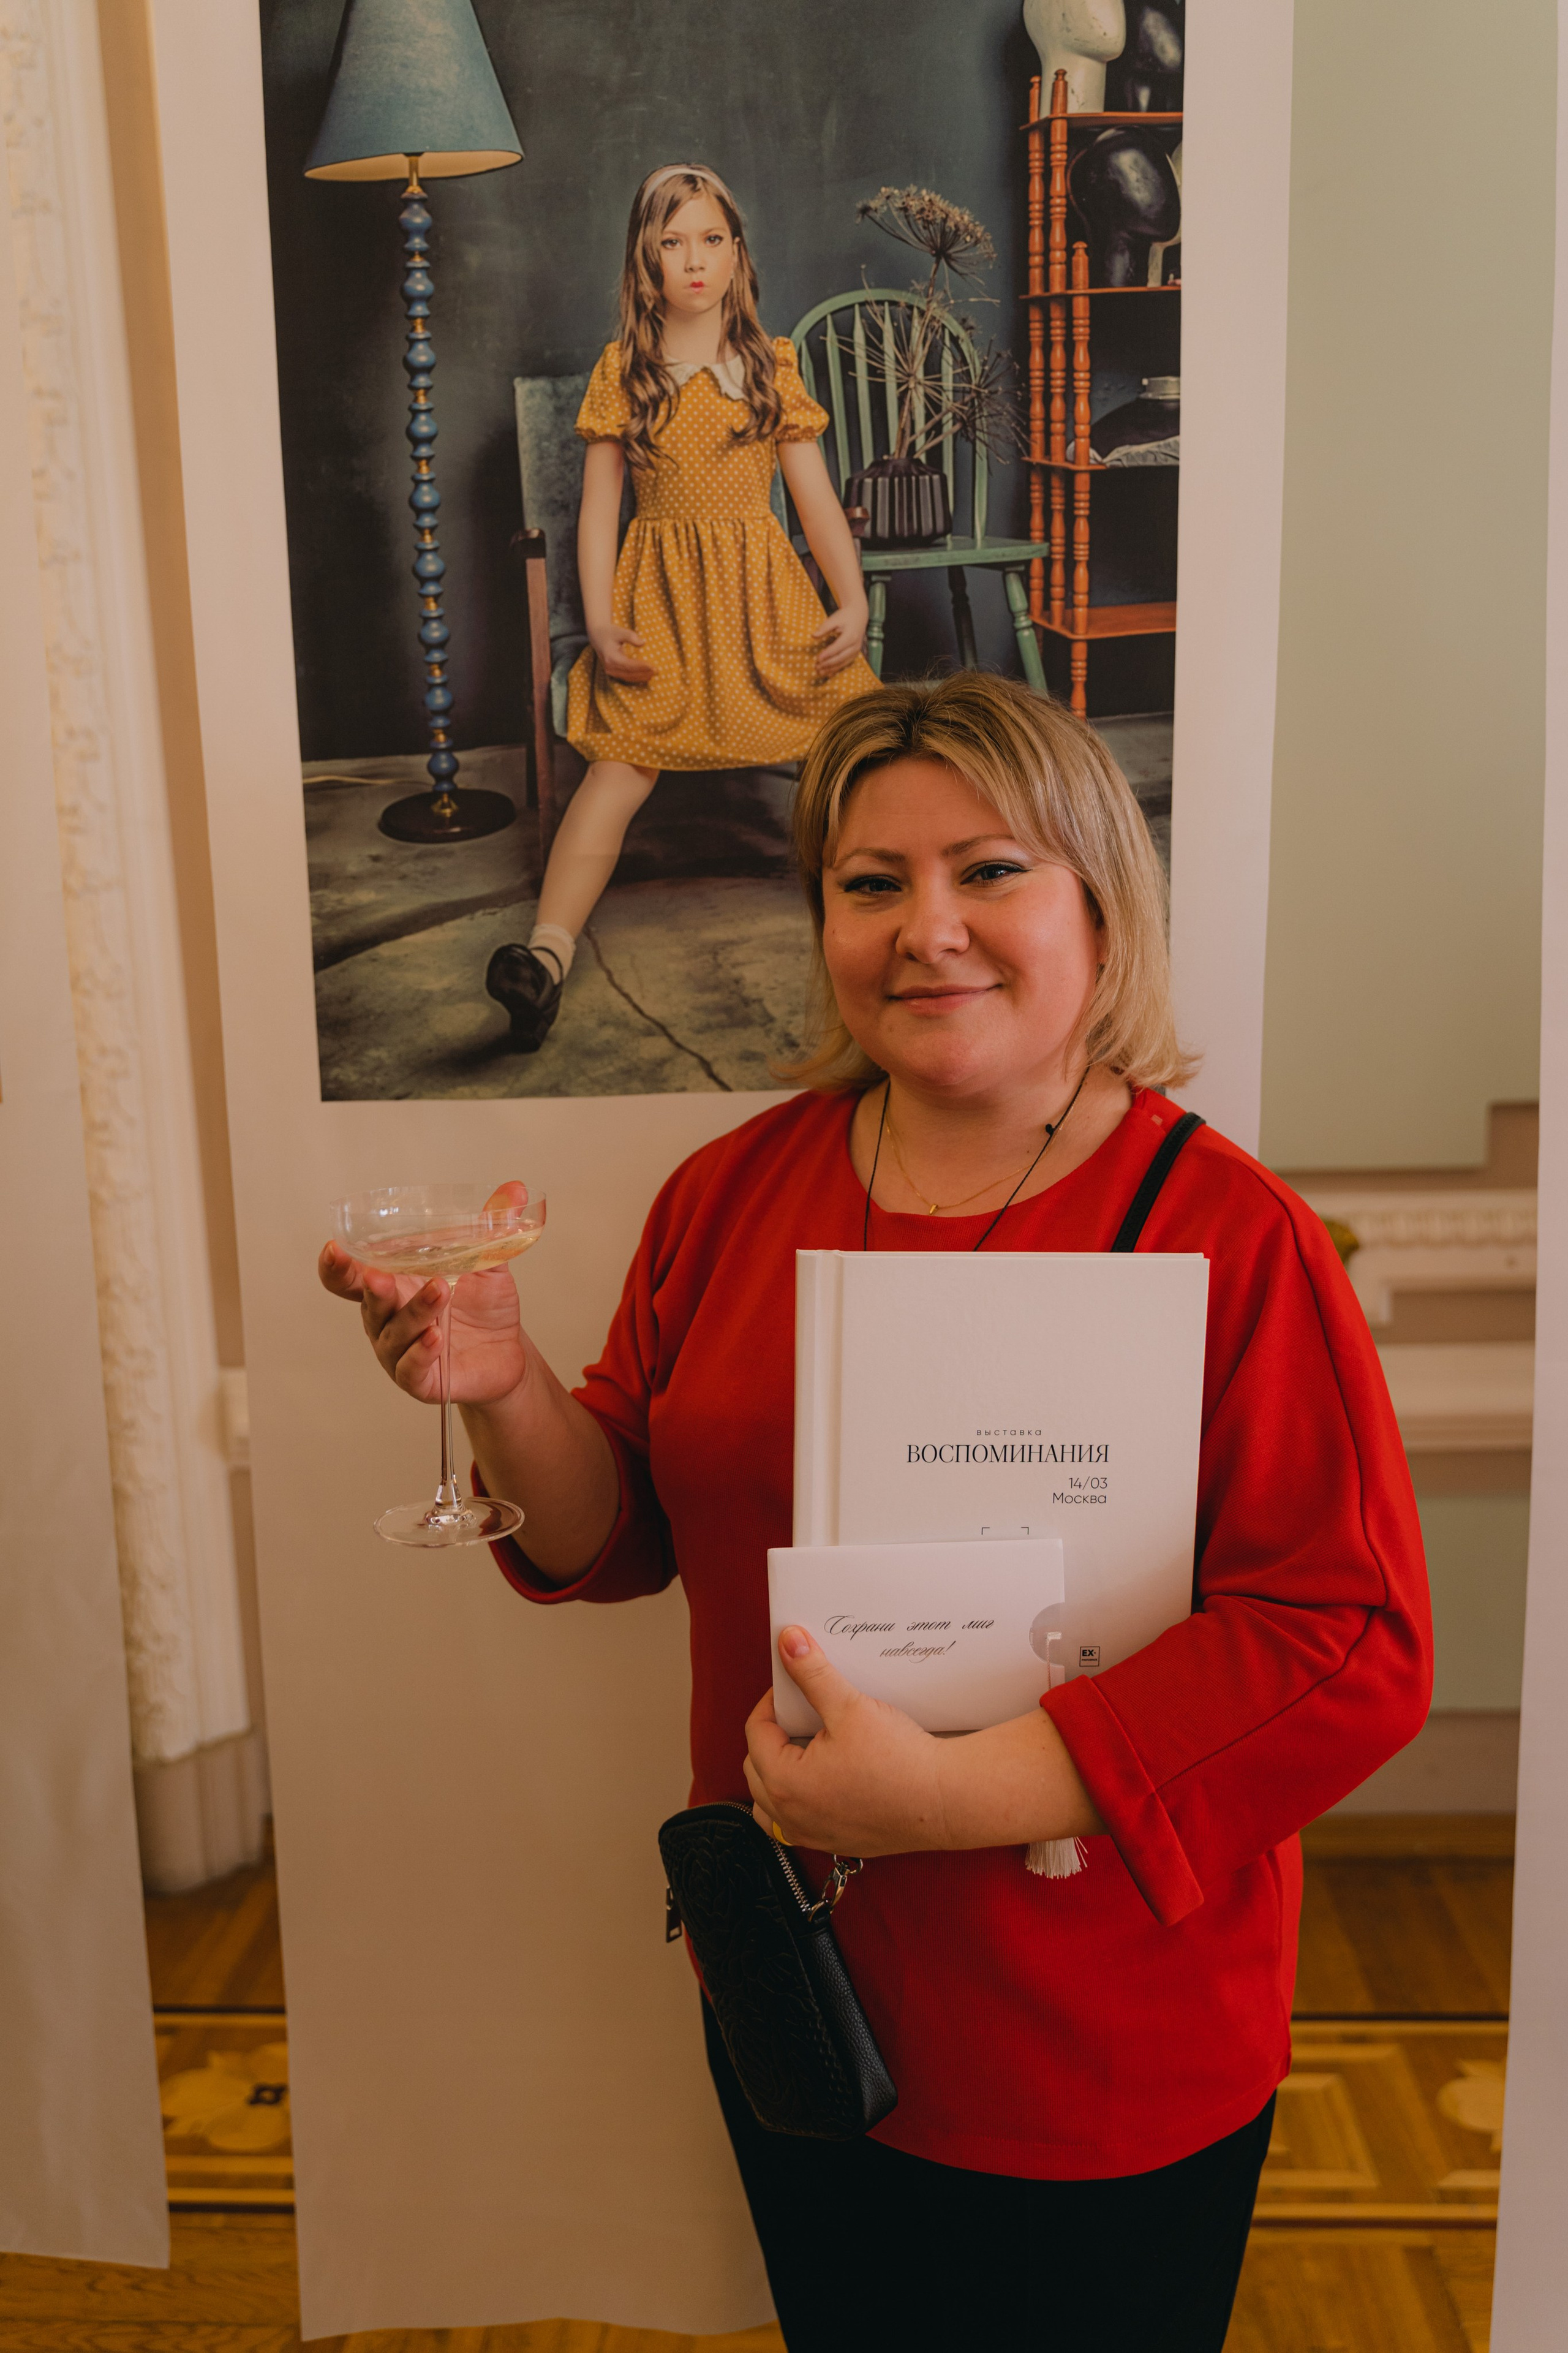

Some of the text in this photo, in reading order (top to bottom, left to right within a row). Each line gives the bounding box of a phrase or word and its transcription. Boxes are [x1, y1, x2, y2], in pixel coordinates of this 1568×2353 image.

[906, 1443, 1110, 1464] ВОСПОМИНАНИЯ
[1068, 1476, 1108, 1490] 14/03
[1052, 1492, 1107, 1505] Москва
[824, 1615, 995, 1641] Сохрани этот миг
[880, 1640, 957, 1664] навсегда!
